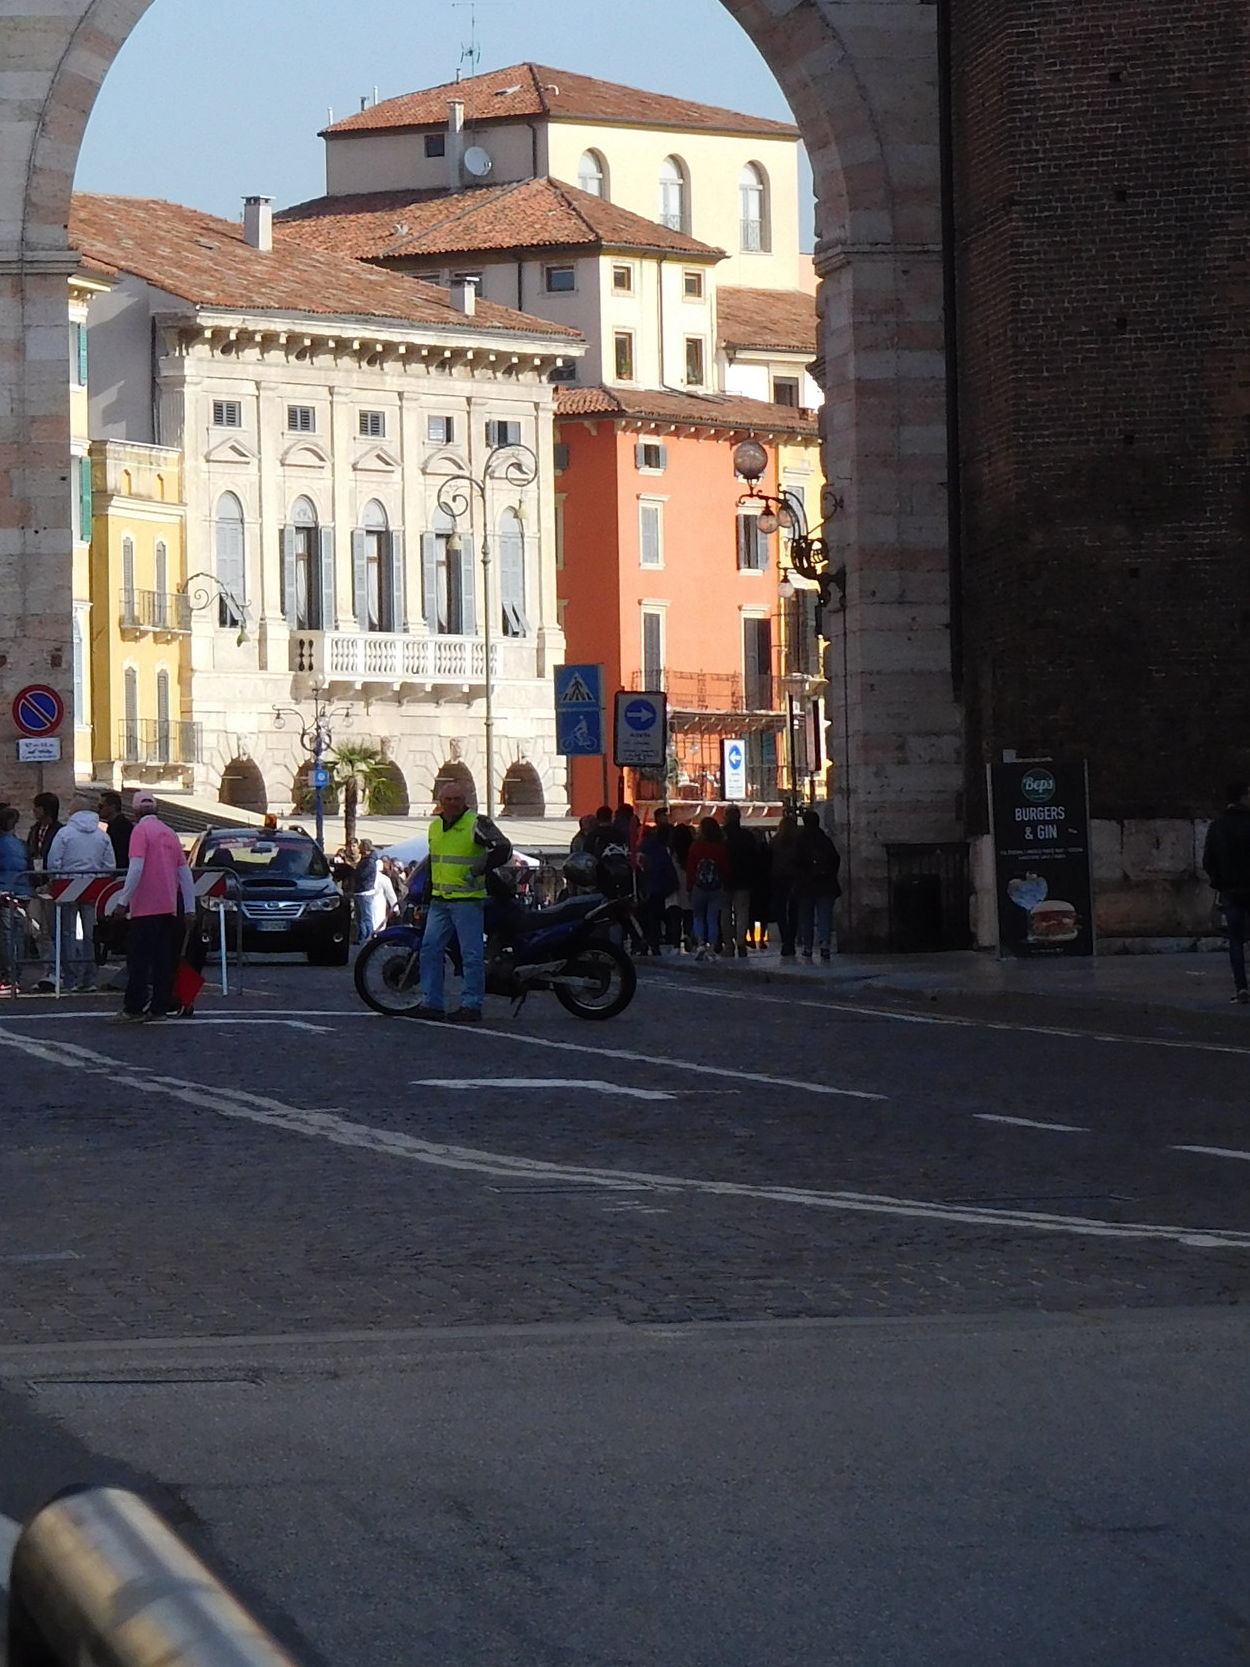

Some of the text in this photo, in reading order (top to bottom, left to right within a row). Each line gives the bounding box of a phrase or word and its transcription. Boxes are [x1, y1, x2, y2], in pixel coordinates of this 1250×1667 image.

[1015, 807, 1066, 821] BURGERS
[1025, 824, 1058, 840] & GIN
